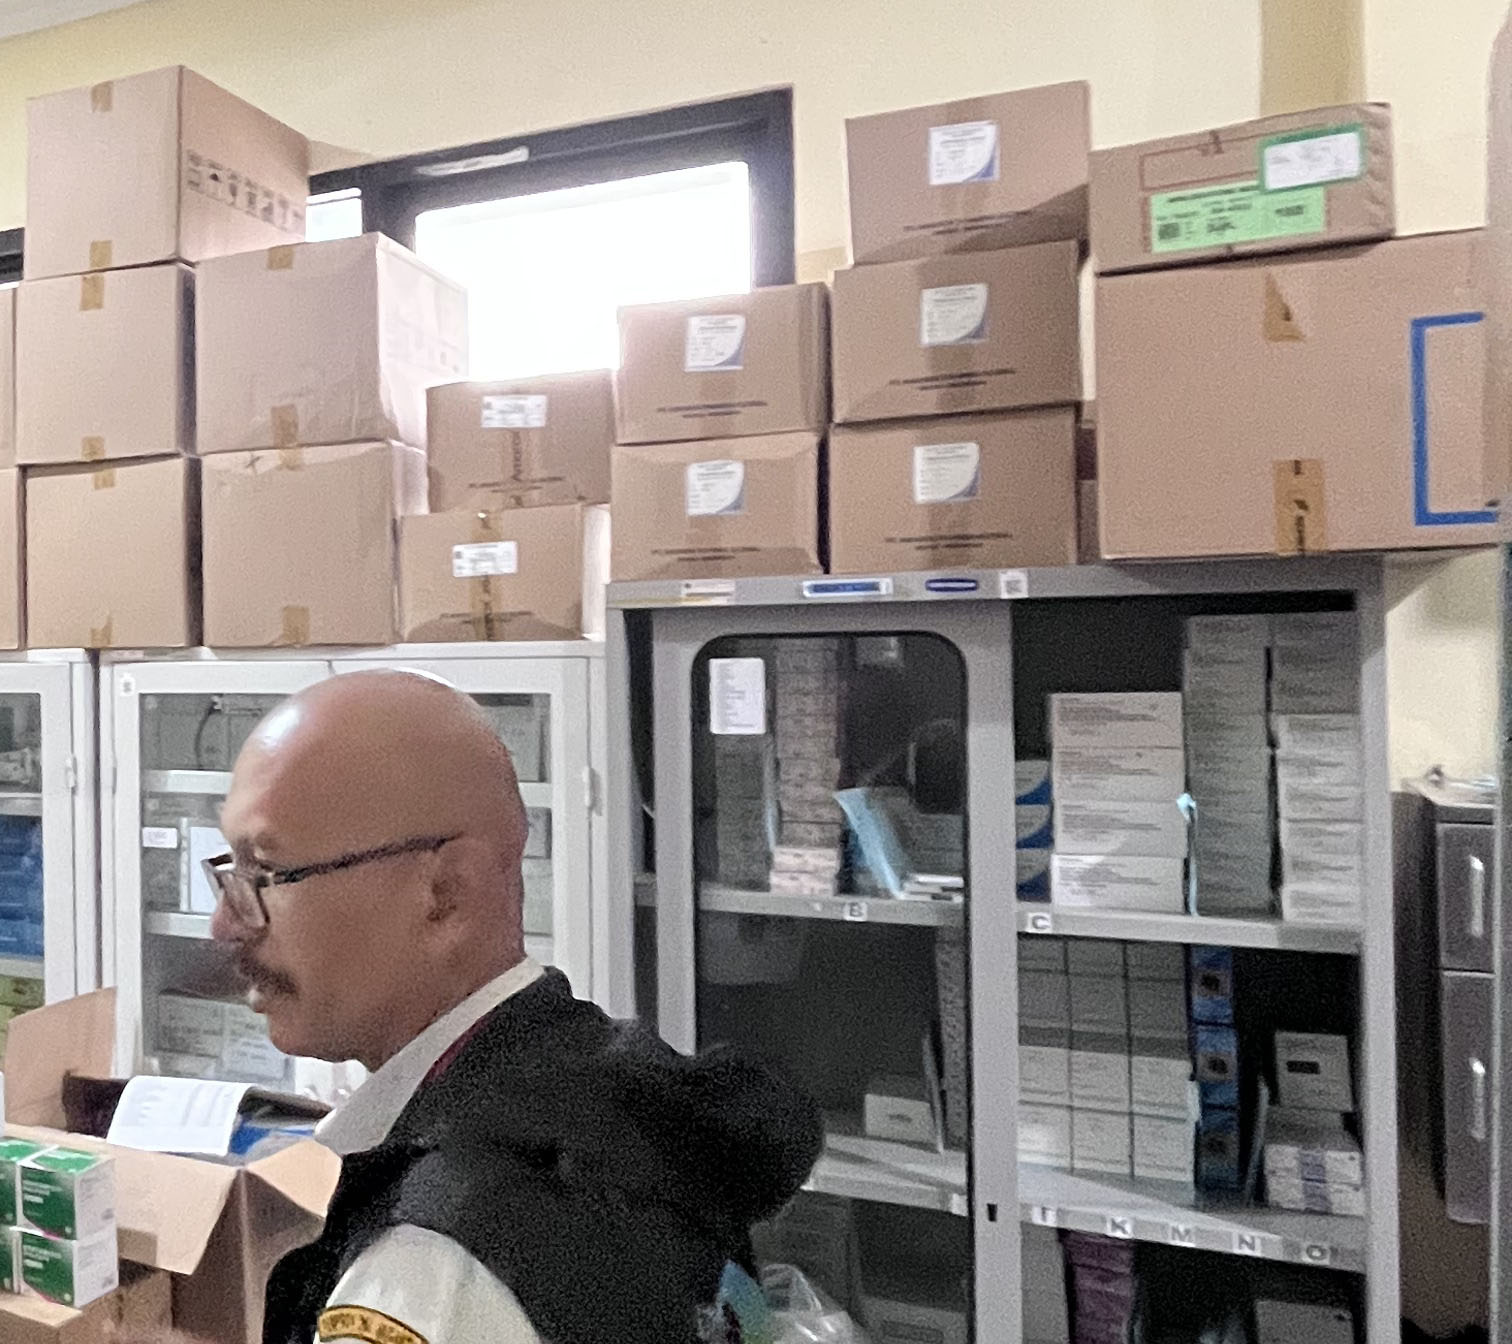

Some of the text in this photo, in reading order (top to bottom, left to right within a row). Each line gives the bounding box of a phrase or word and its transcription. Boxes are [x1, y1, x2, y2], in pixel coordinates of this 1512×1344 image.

[849, 902, 865, 917] B
[1031, 915, 1051, 930] C
[1110, 1217, 1129, 1235] K
[1238, 1234, 1256, 1252] N
